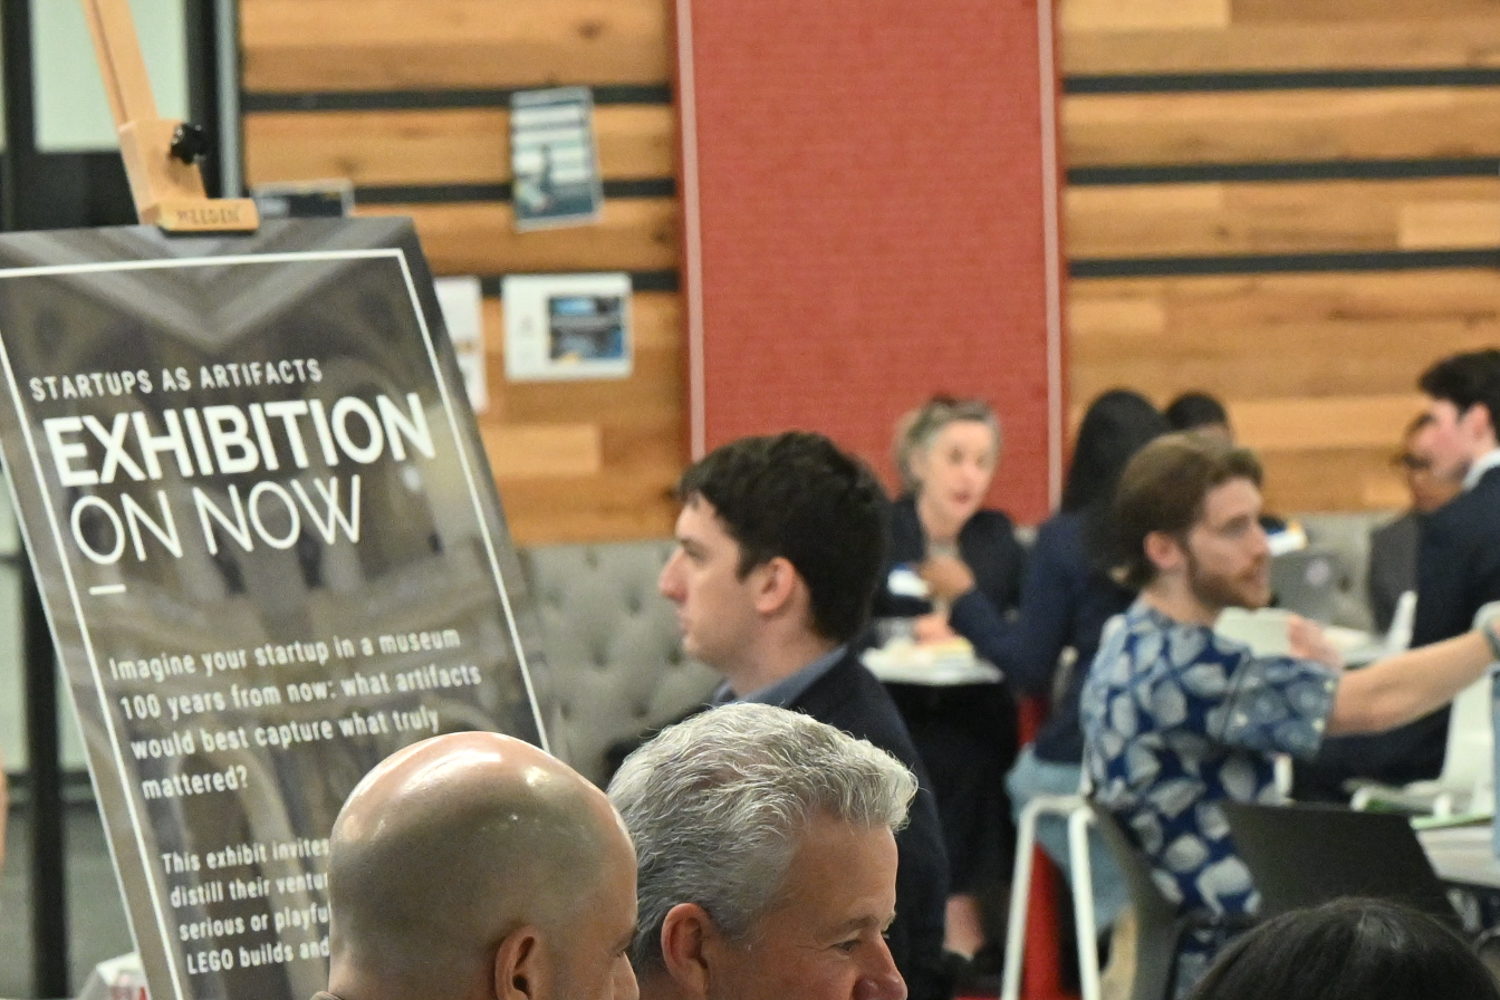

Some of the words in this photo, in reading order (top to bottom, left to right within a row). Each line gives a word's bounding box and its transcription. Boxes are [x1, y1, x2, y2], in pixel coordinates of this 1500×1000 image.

[29, 369, 153, 402] STARTUPS
[161, 367, 192, 392] AS
[200, 358, 323, 389] ARTIFACTS
[43, 393, 436, 487] EXHIBITION
[70, 489, 183, 565] ON
[192, 473, 361, 555] NOW
[108, 652, 196, 683] Imagine
[201, 649, 247, 677] your
[253, 639, 329, 667] startup
[333, 634, 355, 658] in
[360, 637, 374, 657] a
[378, 629, 461, 654] museum
[120, 693, 161, 720] 100
[166, 691, 226, 722] years
[230, 682, 282, 709] from
[286, 680, 337, 703] now:
[340, 672, 390, 697] what
[395, 663, 482, 692] artifacts
[130, 729, 196, 760] would
[199, 726, 249, 752] best
[253, 720, 334, 750] capture
[337, 711, 389, 737] what
[391, 704, 439, 734] truly
[141, 764, 248, 799] mattered?
[161, 851, 201, 875] This
[205, 842, 267, 870] exhibit
[170, 880, 224, 908] distill
[228, 876, 270, 900] their
[179, 916, 245, 941] serious
[250, 913, 268, 932] or
[186, 948, 234, 975] LEGO
[238, 941, 294, 968] builds
[299, 933, 330, 960] and
